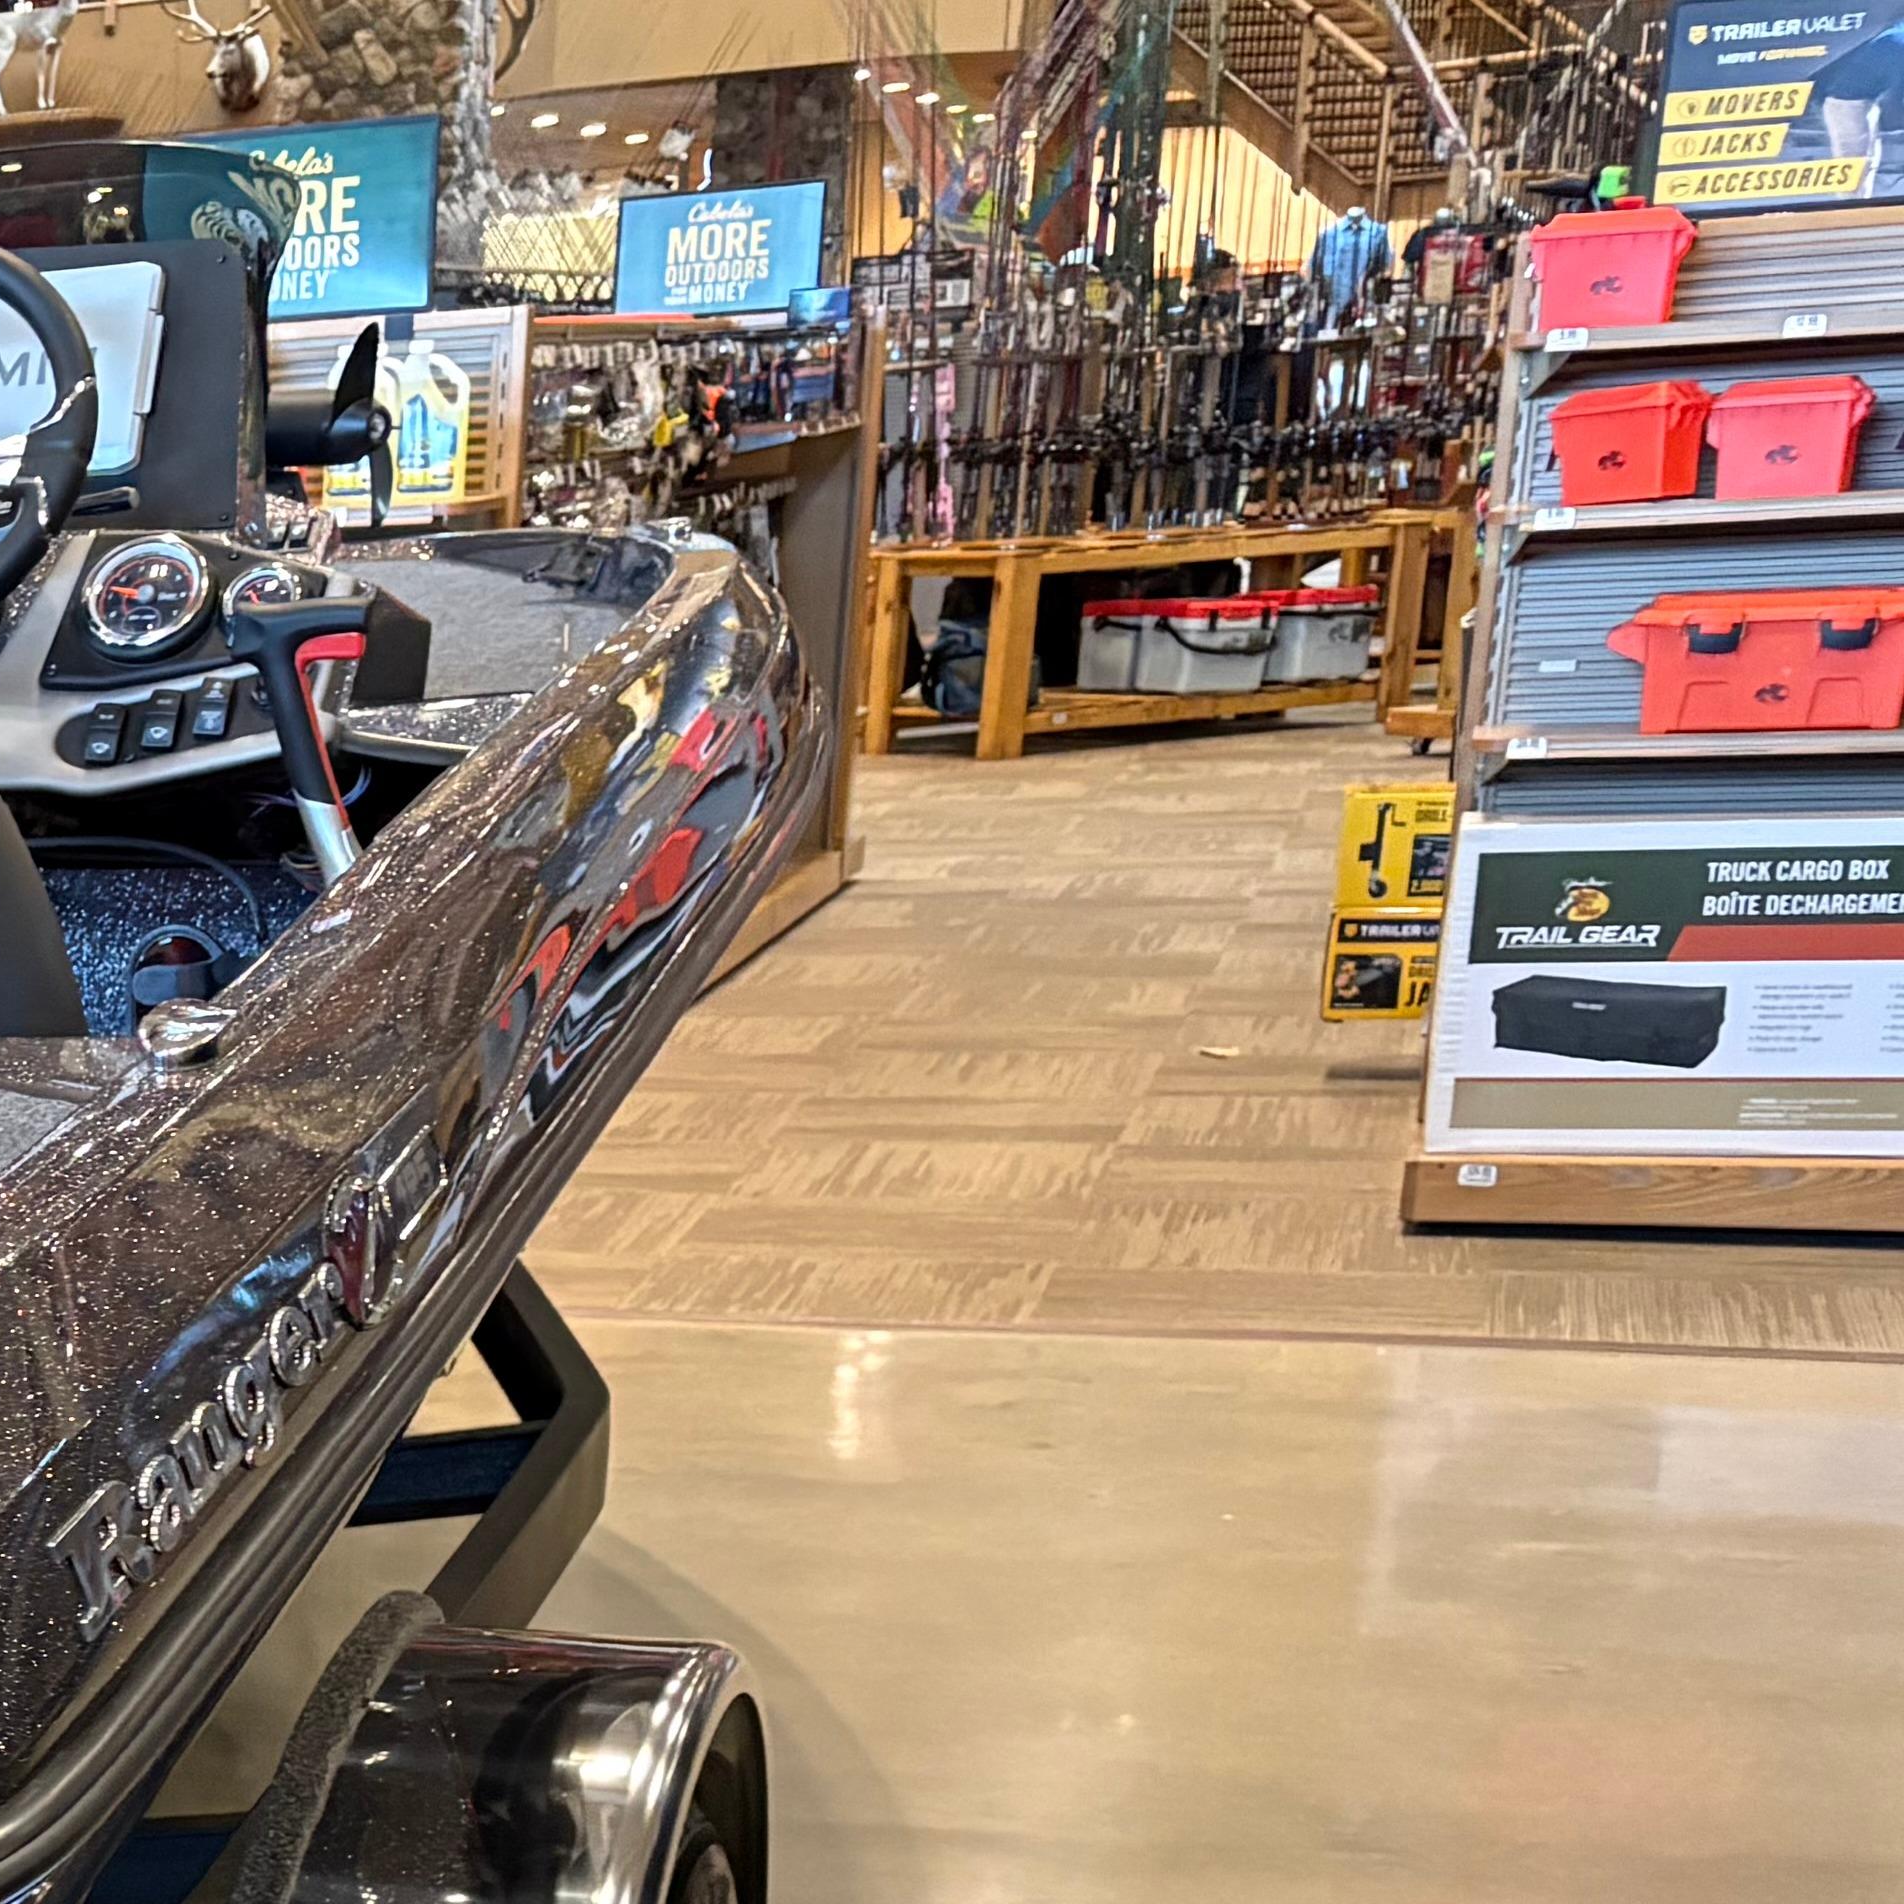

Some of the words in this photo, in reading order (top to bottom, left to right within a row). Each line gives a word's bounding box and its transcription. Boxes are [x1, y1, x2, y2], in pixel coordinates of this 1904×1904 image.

[1704, 89, 1800, 116] MOVERS
[1699, 130, 1773, 157] JACKS
[1694, 164, 1853, 195] ACCESSORIES
[667, 218, 773, 264] MORE
[664, 257, 769, 288] OUTDOORS
[688, 281, 749, 304] MONEY
[1707, 861, 1773, 882] TRUCK
[1776, 859, 1844, 881] CARGO
[1848, 859, 1891, 881] BOX
[1702, 891, 1761, 916] BOÎTE
[1495, 926, 1573, 951] TRAIL
[1578, 924, 1661, 949] GEAR
[47, 1262, 344, 1641] Ranger
